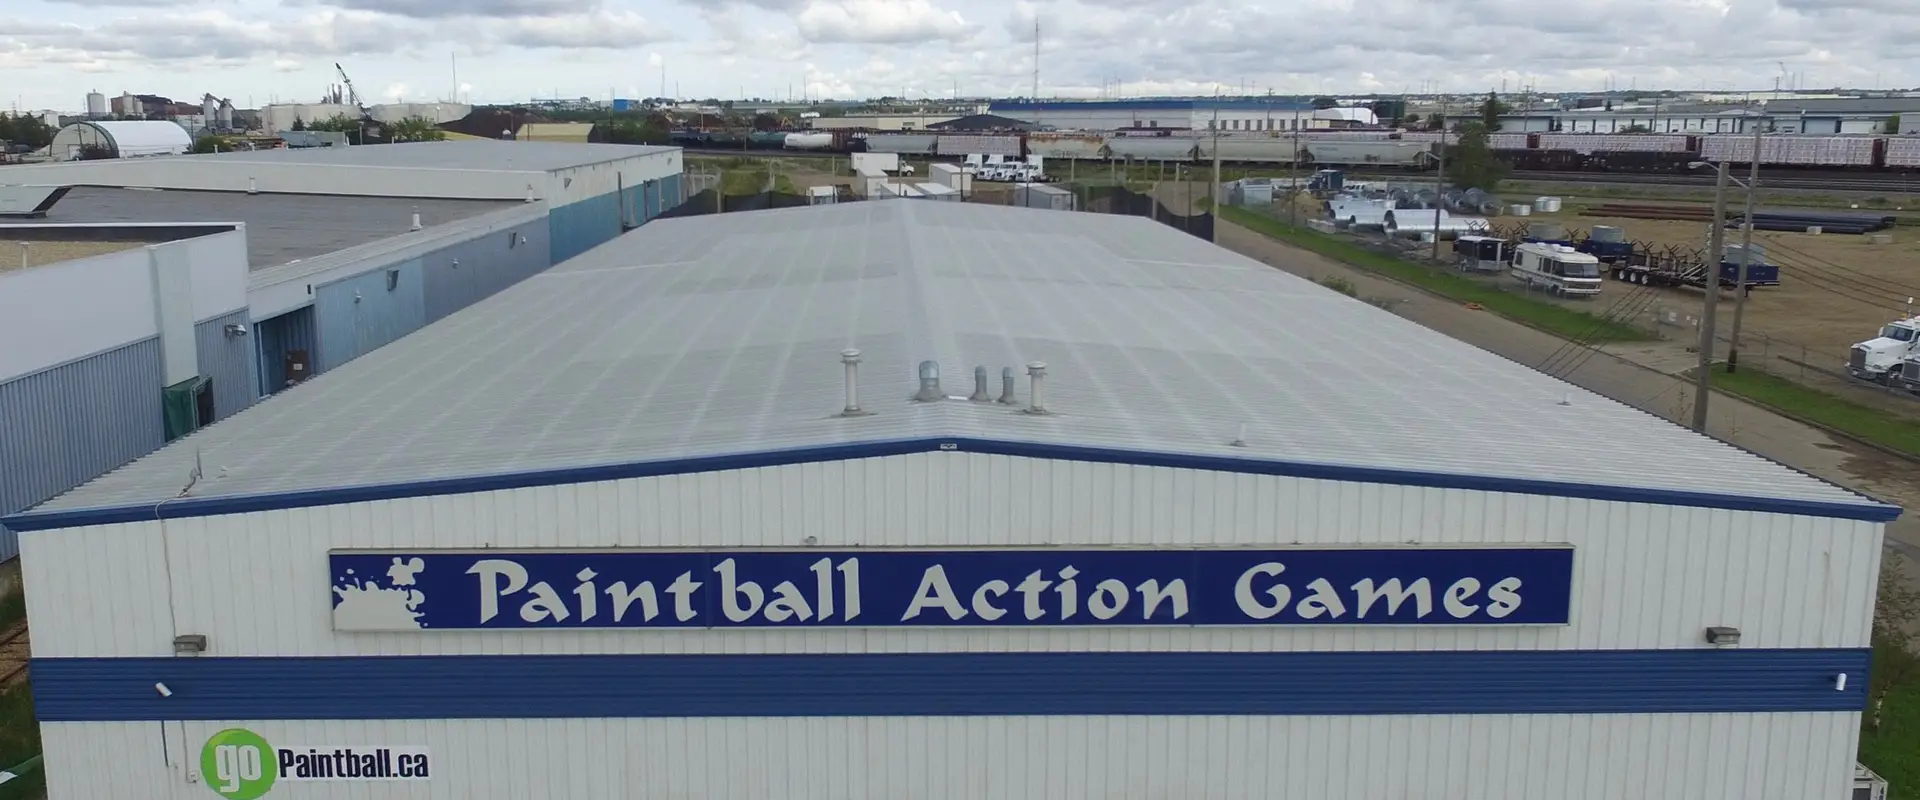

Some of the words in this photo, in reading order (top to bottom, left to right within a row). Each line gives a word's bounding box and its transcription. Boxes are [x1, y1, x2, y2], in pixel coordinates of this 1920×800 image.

[465, 557, 862, 624] Paintball
[901, 563, 1190, 622] Action
[1235, 562, 1523, 619] Games
[215, 744, 262, 794] go
[278, 748, 429, 778] Paintball.ca
